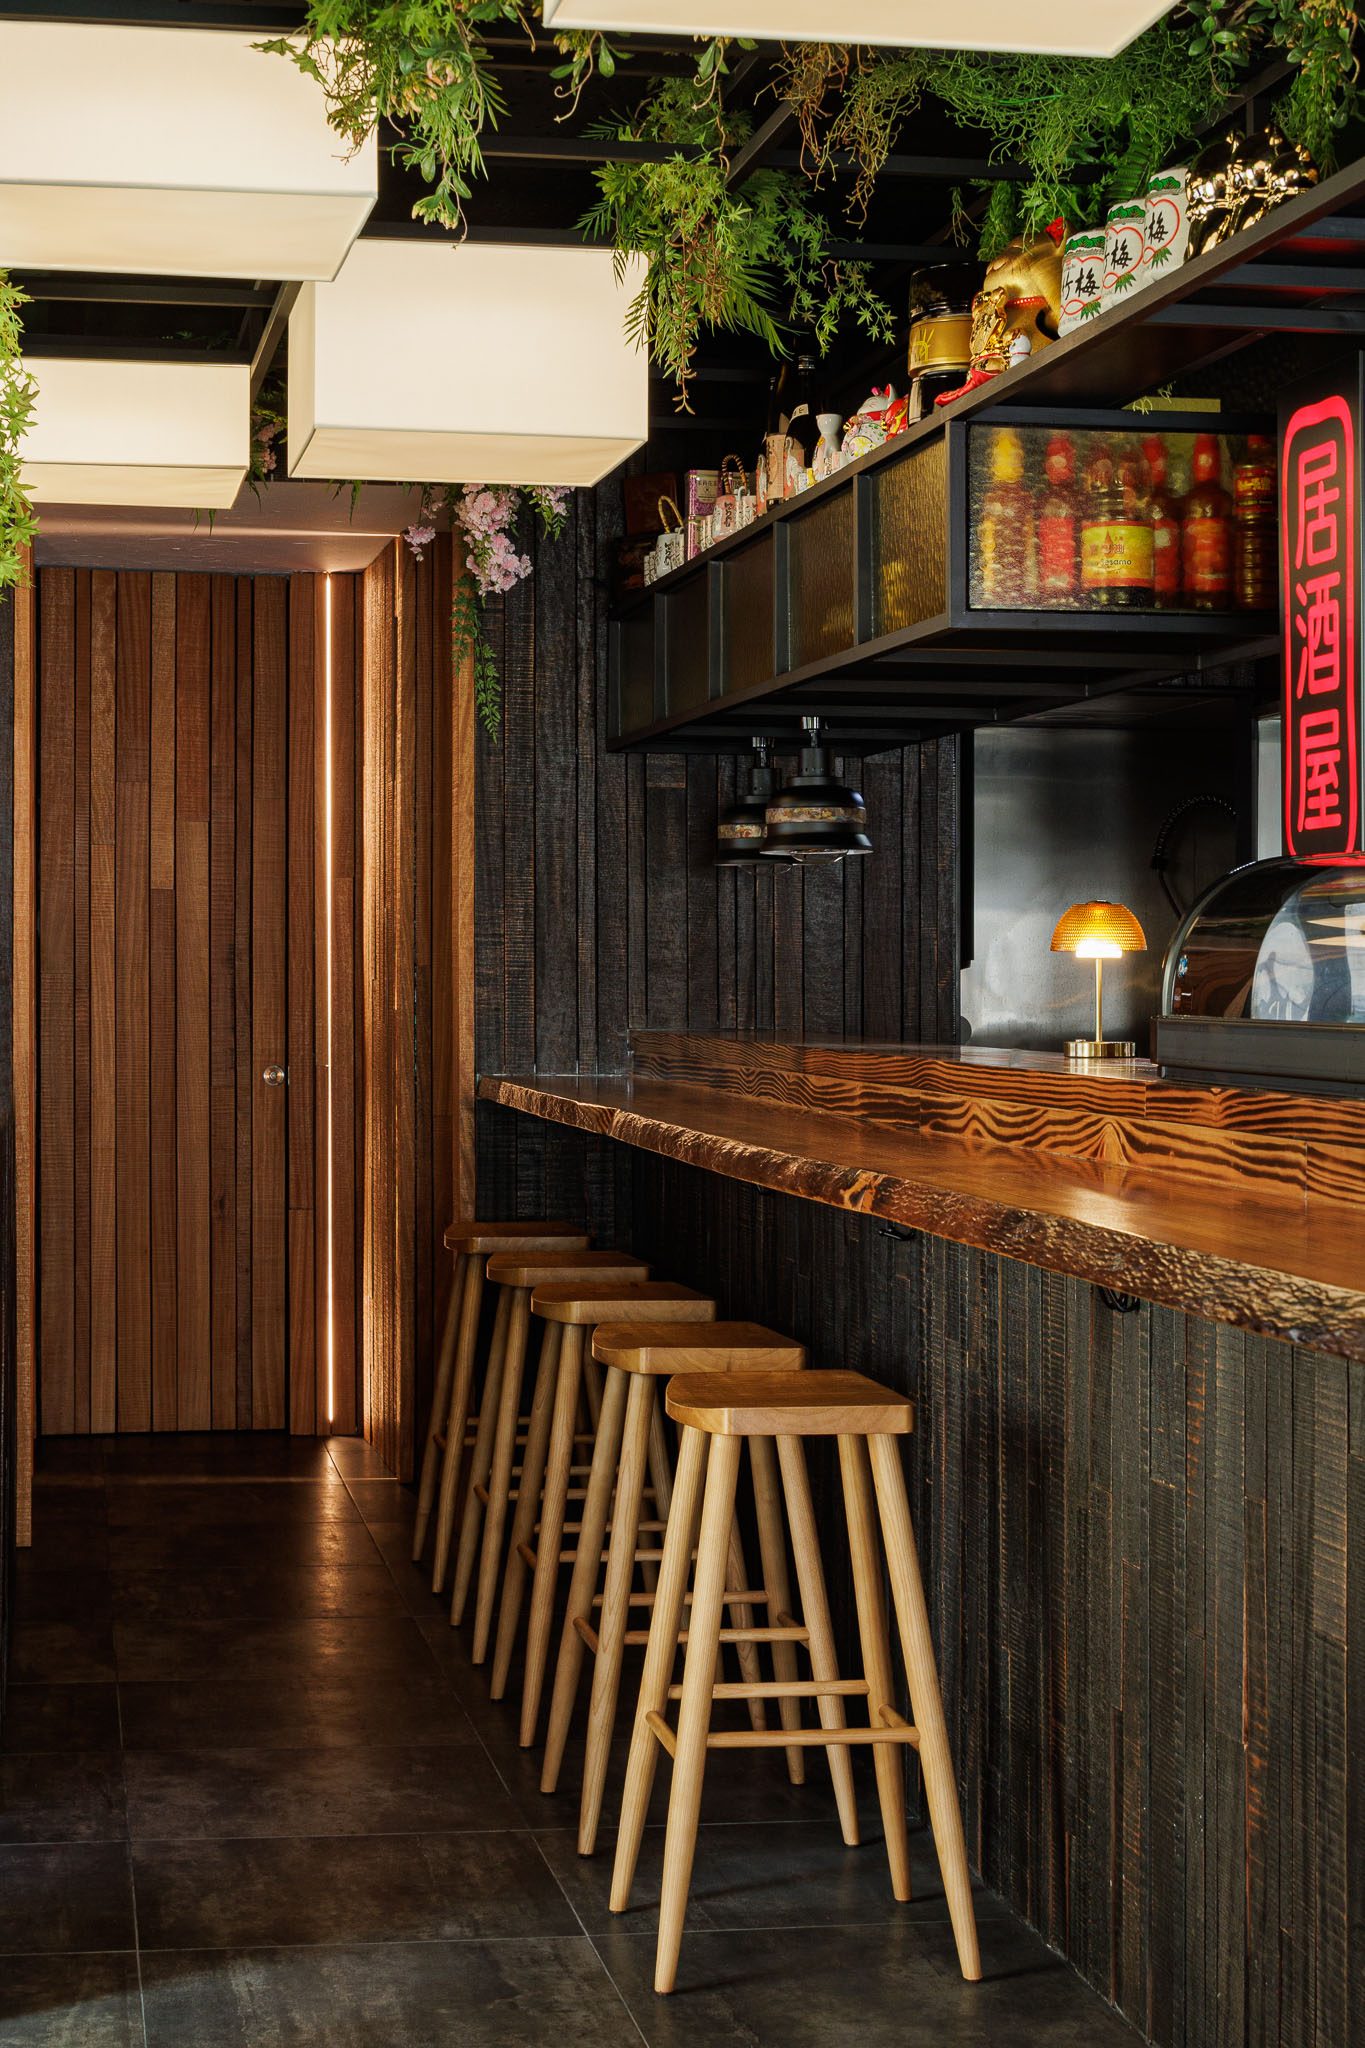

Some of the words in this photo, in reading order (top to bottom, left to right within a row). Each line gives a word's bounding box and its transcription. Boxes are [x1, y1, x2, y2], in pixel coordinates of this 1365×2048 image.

[1143, 211, 1168, 244] 梅
[1295, 440, 1341, 832] 居酒屋
